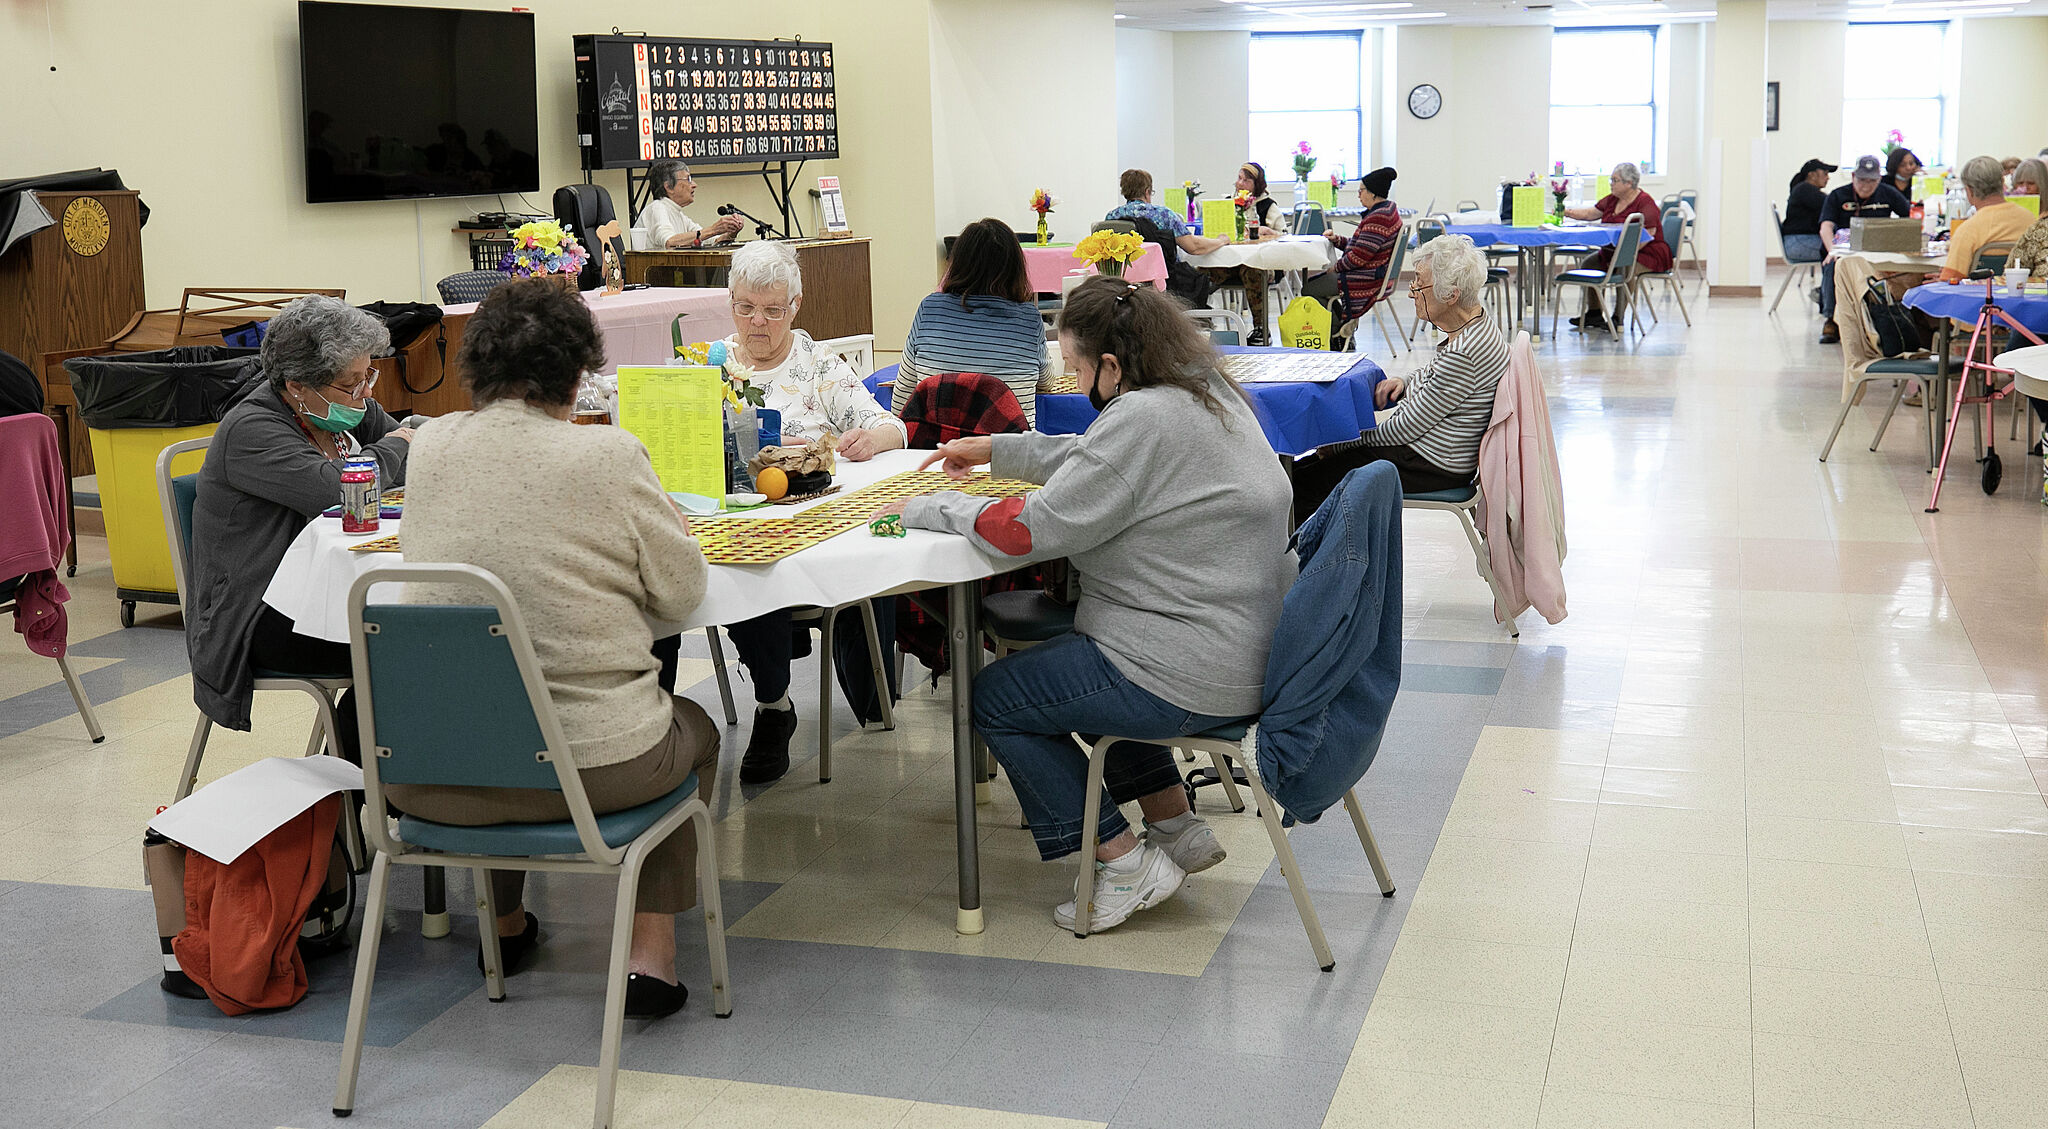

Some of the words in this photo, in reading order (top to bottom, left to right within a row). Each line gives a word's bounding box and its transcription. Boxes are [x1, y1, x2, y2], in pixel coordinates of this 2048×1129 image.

[651, 46, 657, 64] 1
[665, 46, 672, 64] 2
[678, 46, 686, 64] 3
[691, 47, 698, 64] 4
[704, 48, 711, 64] 5
[717, 48, 724, 65] 6
[730, 49, 735, 64] 7
[743, 48, 749, 65] 8
[755, 49, 761, 66] 9
[766, 49, 774, 65] 10
[778, 50, 786, 65] 11
[789, 50, 798, 67] 12
[800, 50, 810, 67] 13
[812, 51, 820, 67] 14
[822, 51, 831, 67] 15
[651, 69, 661, 87] 16
[664, 70, 674, 87] 17
[678, 70, 688, 87] 18
[691, 70, 701, 88] 19
[703, 70, 715, 88] 20
[717, 70, 727, 88] 21
[729, 70, 739, 87] 22
[742, 70, 753, 87] 23
[754, 70, 765, 87] 24
[766, 70, 777, 88] 25
[778, 71, 788, 87] 26
[790, 71, 800, 88] 27
[801, 71, 811, 87] 28
[812, 72, 822, 88] 29
[823, 72, 833, 87] 30
[601, 84, 632, 110] Capital
[652, 93, 664, 111] 31
[666, 93, 677, 110] 32
[679, 93, 690, 110] 33
[692, 93, 703, 110] 34
[705, 93, 716, 110] 35
[718, 93, 729, 110] 36
[730, 93, 741, 110] 37
[744, 93, 754, 110] 38
[756, 93, 766, 109] 39
[768, 93, 778, 109] 40
[780, 93, 790, 109] 41
[791, 93, 801, 109] 42
[803, 93, 813, 109] 43
[814, 93, 823, 109] 44
[825, 93, 834, 109] 45
[654, 116, 665, 133] 46
[668, 116, 678, 134] 47
[681, 116, 692, 133] 48
[694, 116, 705, 133] 49
[707, 116, 718, 133] 50
[720, 116, 729, 132] 51
[732, 115, 742, 132] 52
[745, 115, 756, 132] 53
[757, 115, 768, 131] 54
[769, 115, 780, 131] 55
[781, 114, 791, 131] 56
[792, 114, 801, 130] 57
[803, 114, 813, 131] 58
[814, 114, 824, 131] 59
[826, 114, 835, 130] 60
[655, 140, 666, 158] 61
[668, 140, 680, 158] 62
[682, 140, 693, 157] 63
[695, 140, 706, 156] 64
[708, 139, 719, 156] 65
[721, 139, 731, 156] 66
[733, 138, 743, 155] 67
[746, 137, 757, 153] 68
[759, 136, 768, 153] 69
[770, 136, 780, 152] 70
[782, 136, 792, 152] 71
[794, 136, 803, 152] 72
[804, 135, 814, 152] 73
[816, 135, 825, 151] 74
[827, 136, 836, 151] 75
[64, 210, 73, 228] CITY
[72, 200, 80, 211] OF
[83, 198, 108, 227] MERIDEN
[69, 237, 106, 255] MDCCCLXVII
[1296, 337, 1321, 349] Bag
